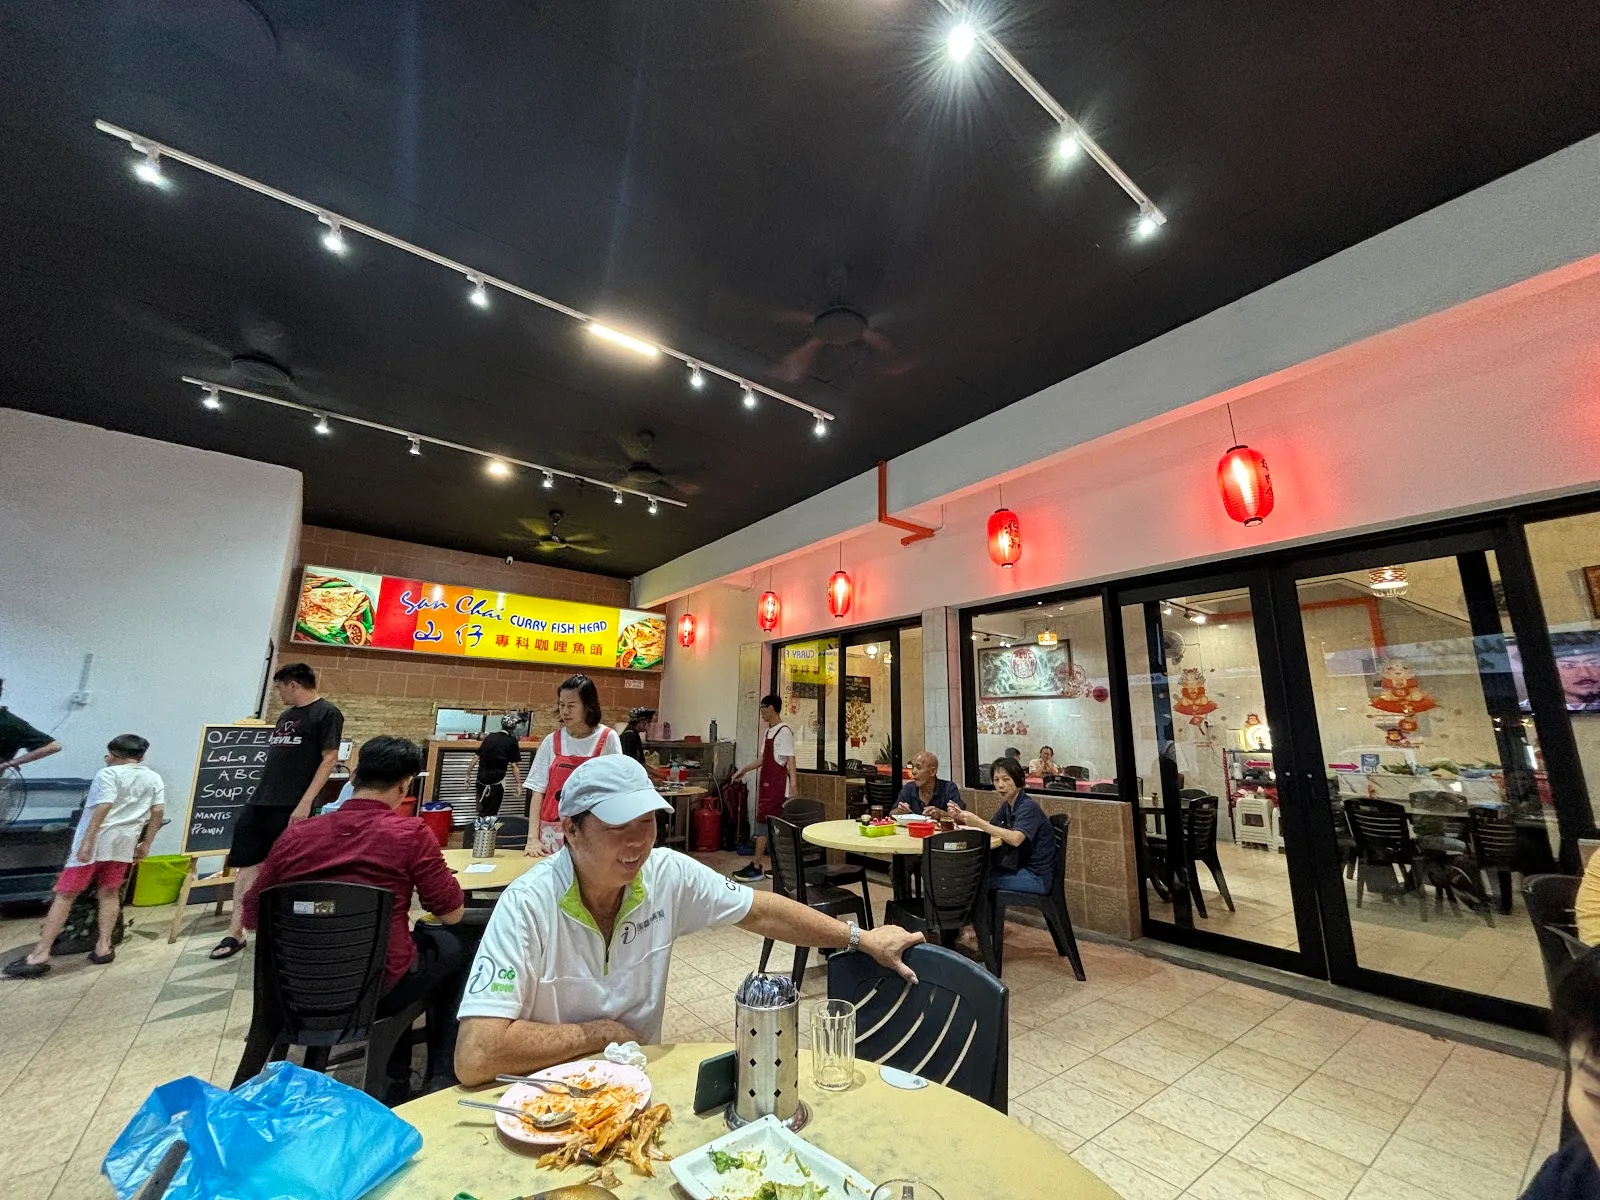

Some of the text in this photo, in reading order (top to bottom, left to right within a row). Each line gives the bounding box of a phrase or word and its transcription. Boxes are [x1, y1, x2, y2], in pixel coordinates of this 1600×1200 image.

[400, 591, 505, 621] San Chai
[510, 615, 608, 634] CURRY FISH HEAD
[201, 783, 243, 801] Soup
